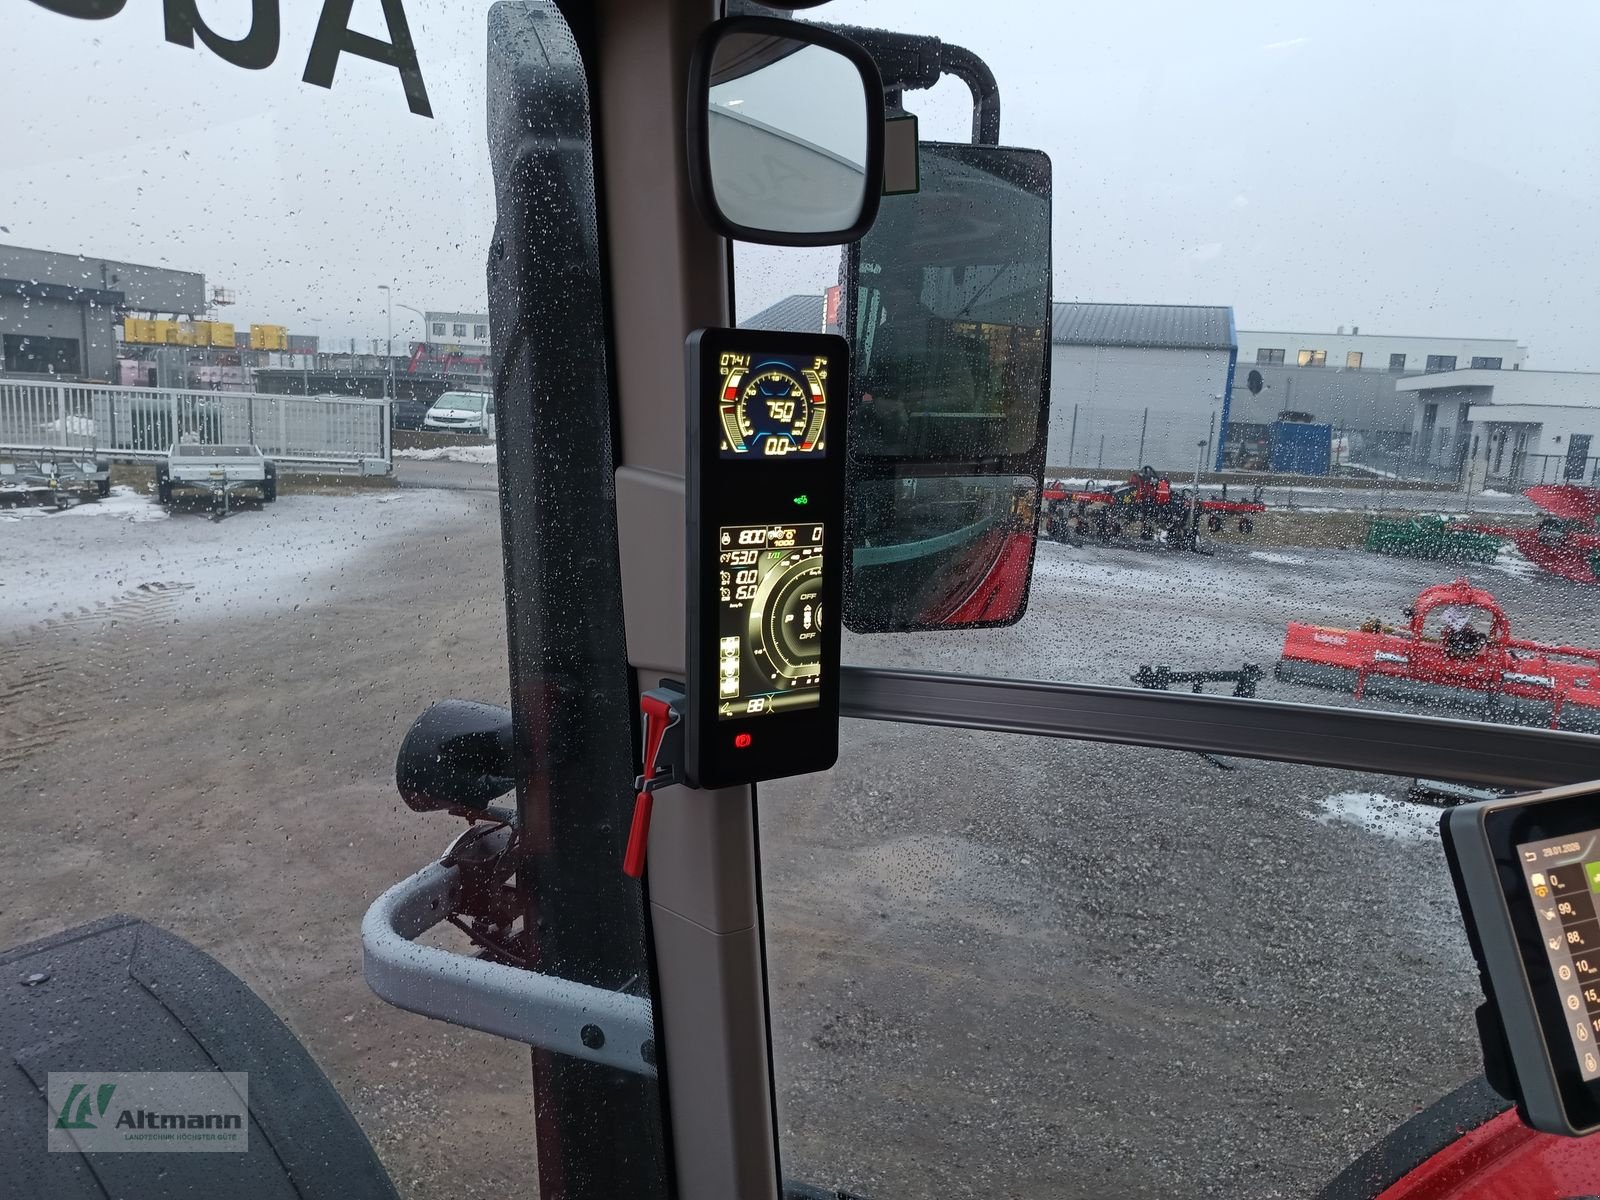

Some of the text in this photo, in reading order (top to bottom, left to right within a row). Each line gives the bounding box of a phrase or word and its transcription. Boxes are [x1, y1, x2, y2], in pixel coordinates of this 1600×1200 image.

[766, 401, 795, 419] 750
[738, 529, 767, 545] 800
[812, 527, 822, 541] 0
[774, 539, 795, 547] 1000
[799, 632, 816, 640] OFF
[1576, 959, 1589, 973] 10
[1584, 988, 1597, 1002] 15
